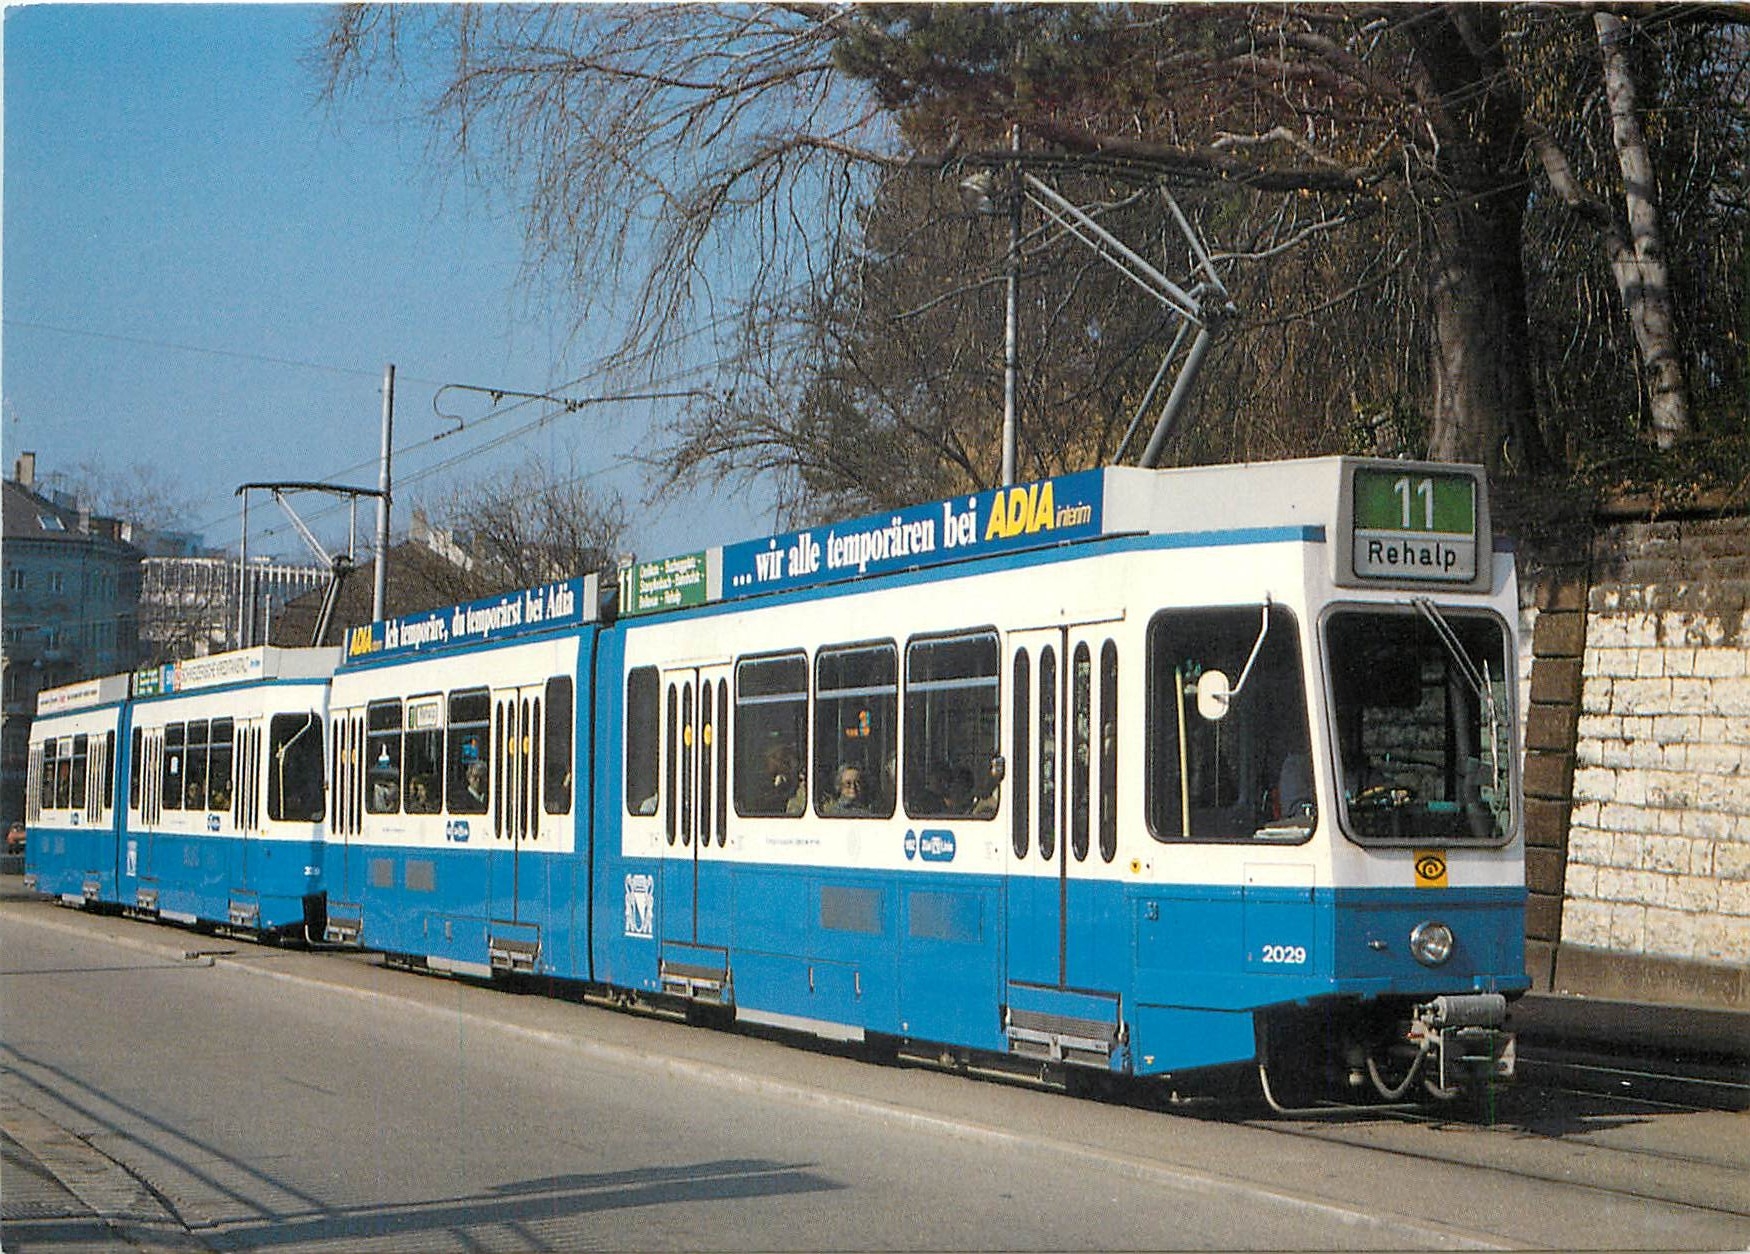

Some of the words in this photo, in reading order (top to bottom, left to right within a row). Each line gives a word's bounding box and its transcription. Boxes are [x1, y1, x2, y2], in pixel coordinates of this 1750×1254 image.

[984, 480, 1055, 541] ADIA
[1394, 476, 1433, 529] 11
[755, 538, 785, 583] wir
[788, 528, 821, 578] alle
[826, 515, 936, 574] temporären
[942, 496, 977, 550] bei
[1367, 540, 1456, 572] Rehalp
[525, 587, 544, 624] bei
[546, 583, 574, 621] Adia
[618, 566, 633, 613] 11
[1262, 944, 1306, 964] 2029
